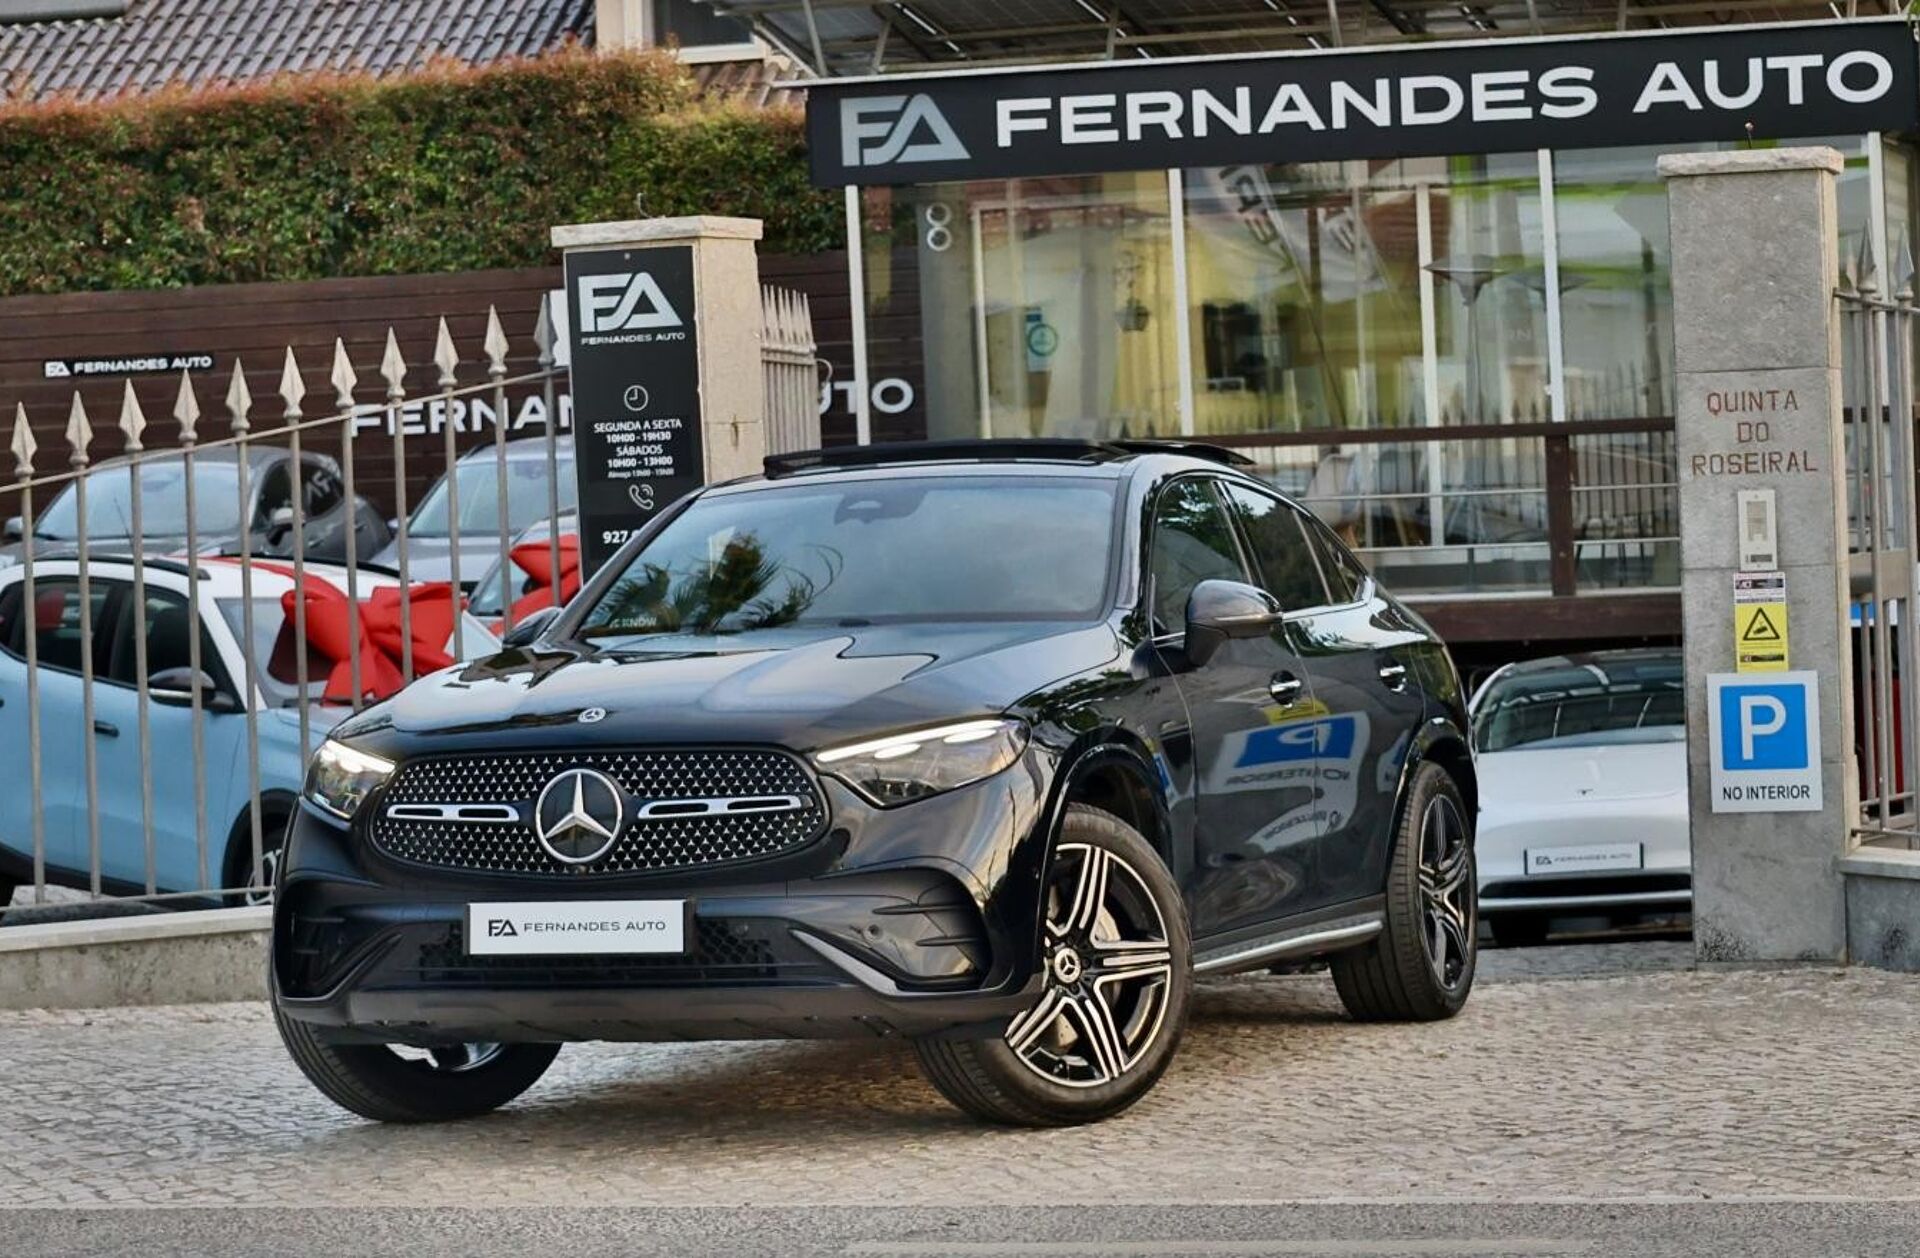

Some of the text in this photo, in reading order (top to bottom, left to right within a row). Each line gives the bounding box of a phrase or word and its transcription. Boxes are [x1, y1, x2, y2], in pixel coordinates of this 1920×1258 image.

[840, 50, 1893, 167] FA FERNANDES AUTO
[578, 271, 683, 332] FA
[581, 332, 685, 345] FERNANDES AUTO
[74, 357, 168, 374] FERNANDES
[171, 356, 212, 369] AUTO
[1707, 389, 1799, 416] QUINTA
[594, 418, 682, 433] SEGUNDA A SEXTA
[1737, 421, 1769, 443] DO
[606, 432, 635, 443] 10H00
[642, 431, 671, 441] 19H30
[616, 444, 663, 457] SÁBADOS
[607, 458, 637, 468] 10H00
[643, 456, 673, 466] 13H00
[1692, 449, 1818, 475] ROSEIRAL
[603, 530, 628, 544] 927
[1740, 694, 1787, 760] P
[1723, 785, 1810, 800] NO INTERIOR
[488, 919, 666, 937] FA FERNANDES AUTO
